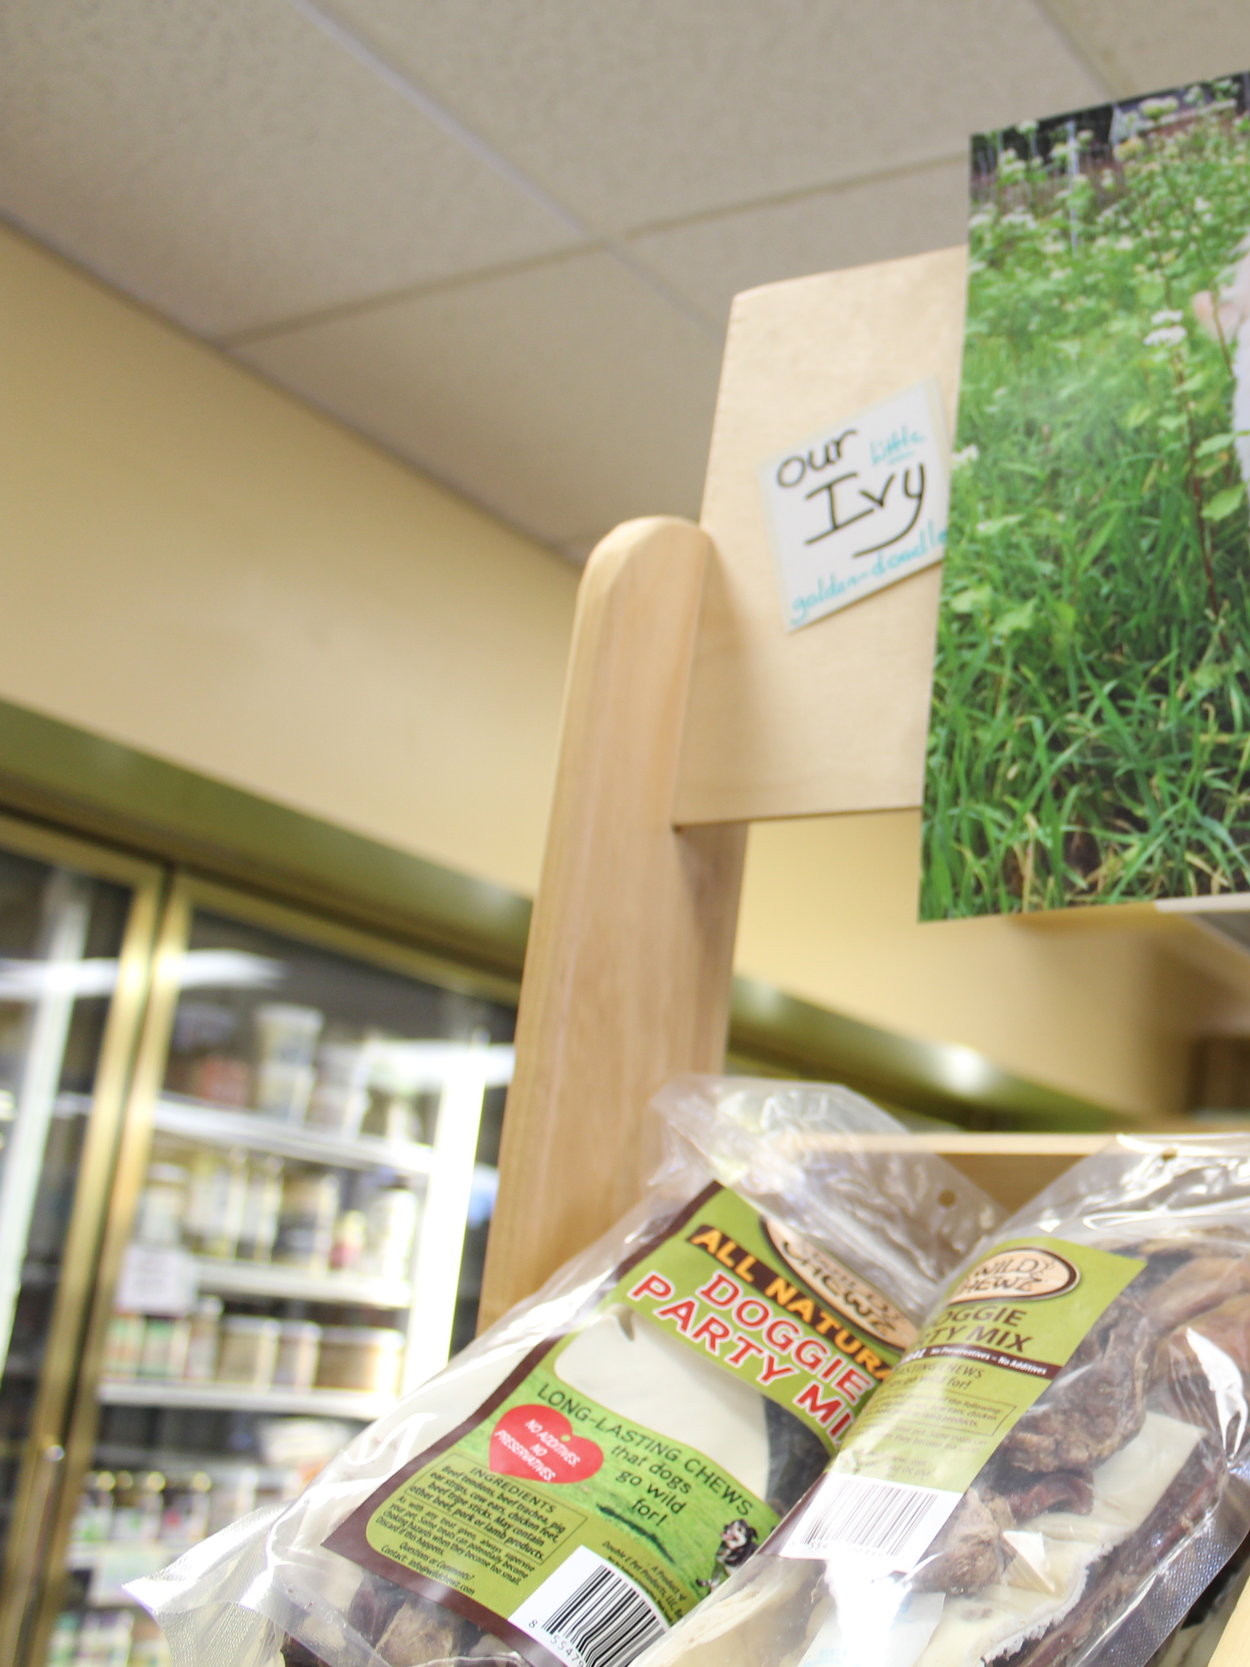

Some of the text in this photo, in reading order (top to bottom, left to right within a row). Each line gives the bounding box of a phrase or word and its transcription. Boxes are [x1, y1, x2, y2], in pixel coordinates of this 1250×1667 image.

[804, 463, 926, 558] Ivy
[690, 1228, 756, 1282] ALL
[764, 1278, 893, 1379] NATUR
[964, 1275, 1042, 1292] HEWZ
[697, 1273, 873, 1403] DOGGIE
[937, 1305, 1027, 1327] OGGIE
[966, 1325, 1033, 1353] MIX
[630, 1273, 795, 1384] PARTY
[795, 1382, 853, 1439] MI
[1010, 1359, 1047, 1375] Additives
[524, 1417, 543, 1435] NO
[529, 1441, 547, 1458] NO
[536, 1382, 754, 1517] LONG-LASTING CHEWS
[470, 1465, 555, 1514] INGREDIENTS
[610, 1443, 693, 1495] that dogs
[615, 1469, 686, 1516] go wild
[409, 1484, 432, 1500] other
[453, 1507, 474, 1523] pork
[474, 1518, 484, 1528] or
[483, 1523, 506, 1539] lamb
[428, 1481, 447, 1495] beef
[493, 1516, 512, 1531] May
[512, 1525, 544, 1546] contain
[430, 1471, 445, 1482] ear
[470, 1492, 486, 1504] cow
[508, 1510, 540, 1531] chicken
[497, 1492, 518, 1507] beef
[549, 1520, 565, 1533] pig
[630, 1497, 668, 1527] for!
[529, 1620, 538, 1629] 8
